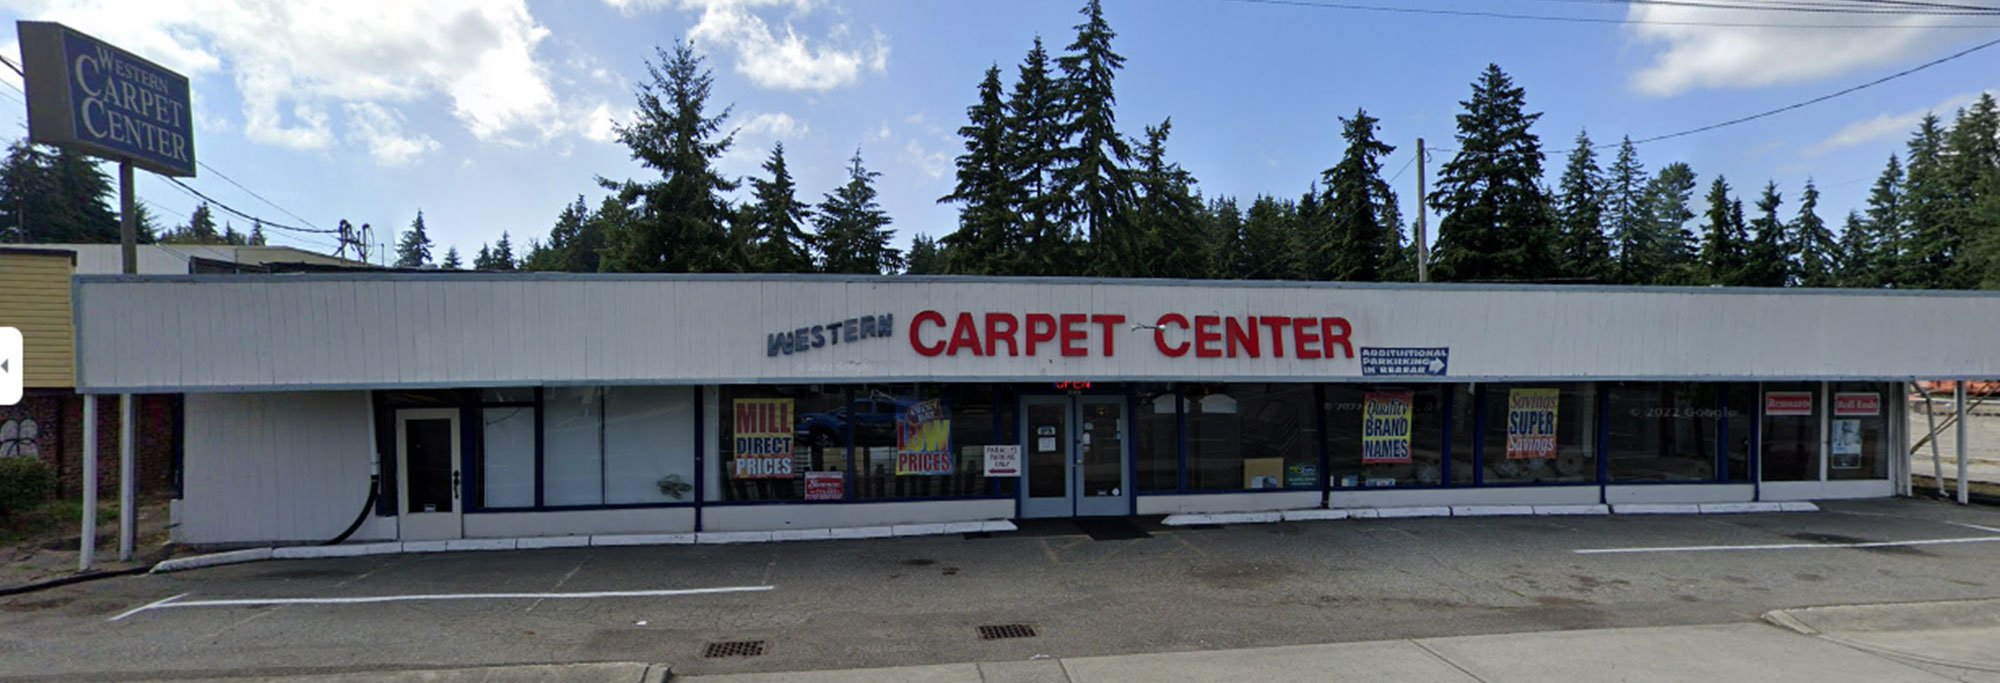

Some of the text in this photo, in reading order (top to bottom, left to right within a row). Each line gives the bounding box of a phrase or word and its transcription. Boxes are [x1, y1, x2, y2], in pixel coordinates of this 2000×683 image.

[95, 45, 168, 95] WESTERN
[75, 54, 183, 130] CARPET
[81, 98, 188, 163] CENTER
[766, 309, 1355, 360] WESTERN CARPET CENTER
[1367, 398, 1409, 419] Quality
[1510, 392, 1556, 412] Savings
[736, 402, 791, 434] MILL
[1365, 419, 1408, 437] BRAND
[1509, 411, 1554, 435] SUPER
[736, 437, 791, 455] DIRECT
[897, 420, 950, 451] LOW
[1508, 436, 1554, 456] Savings
[1364, 440, 1409, 458] NAMES
[736, 458, 791, 476] PRICES
[898, 453, 950, 472] PRICES
